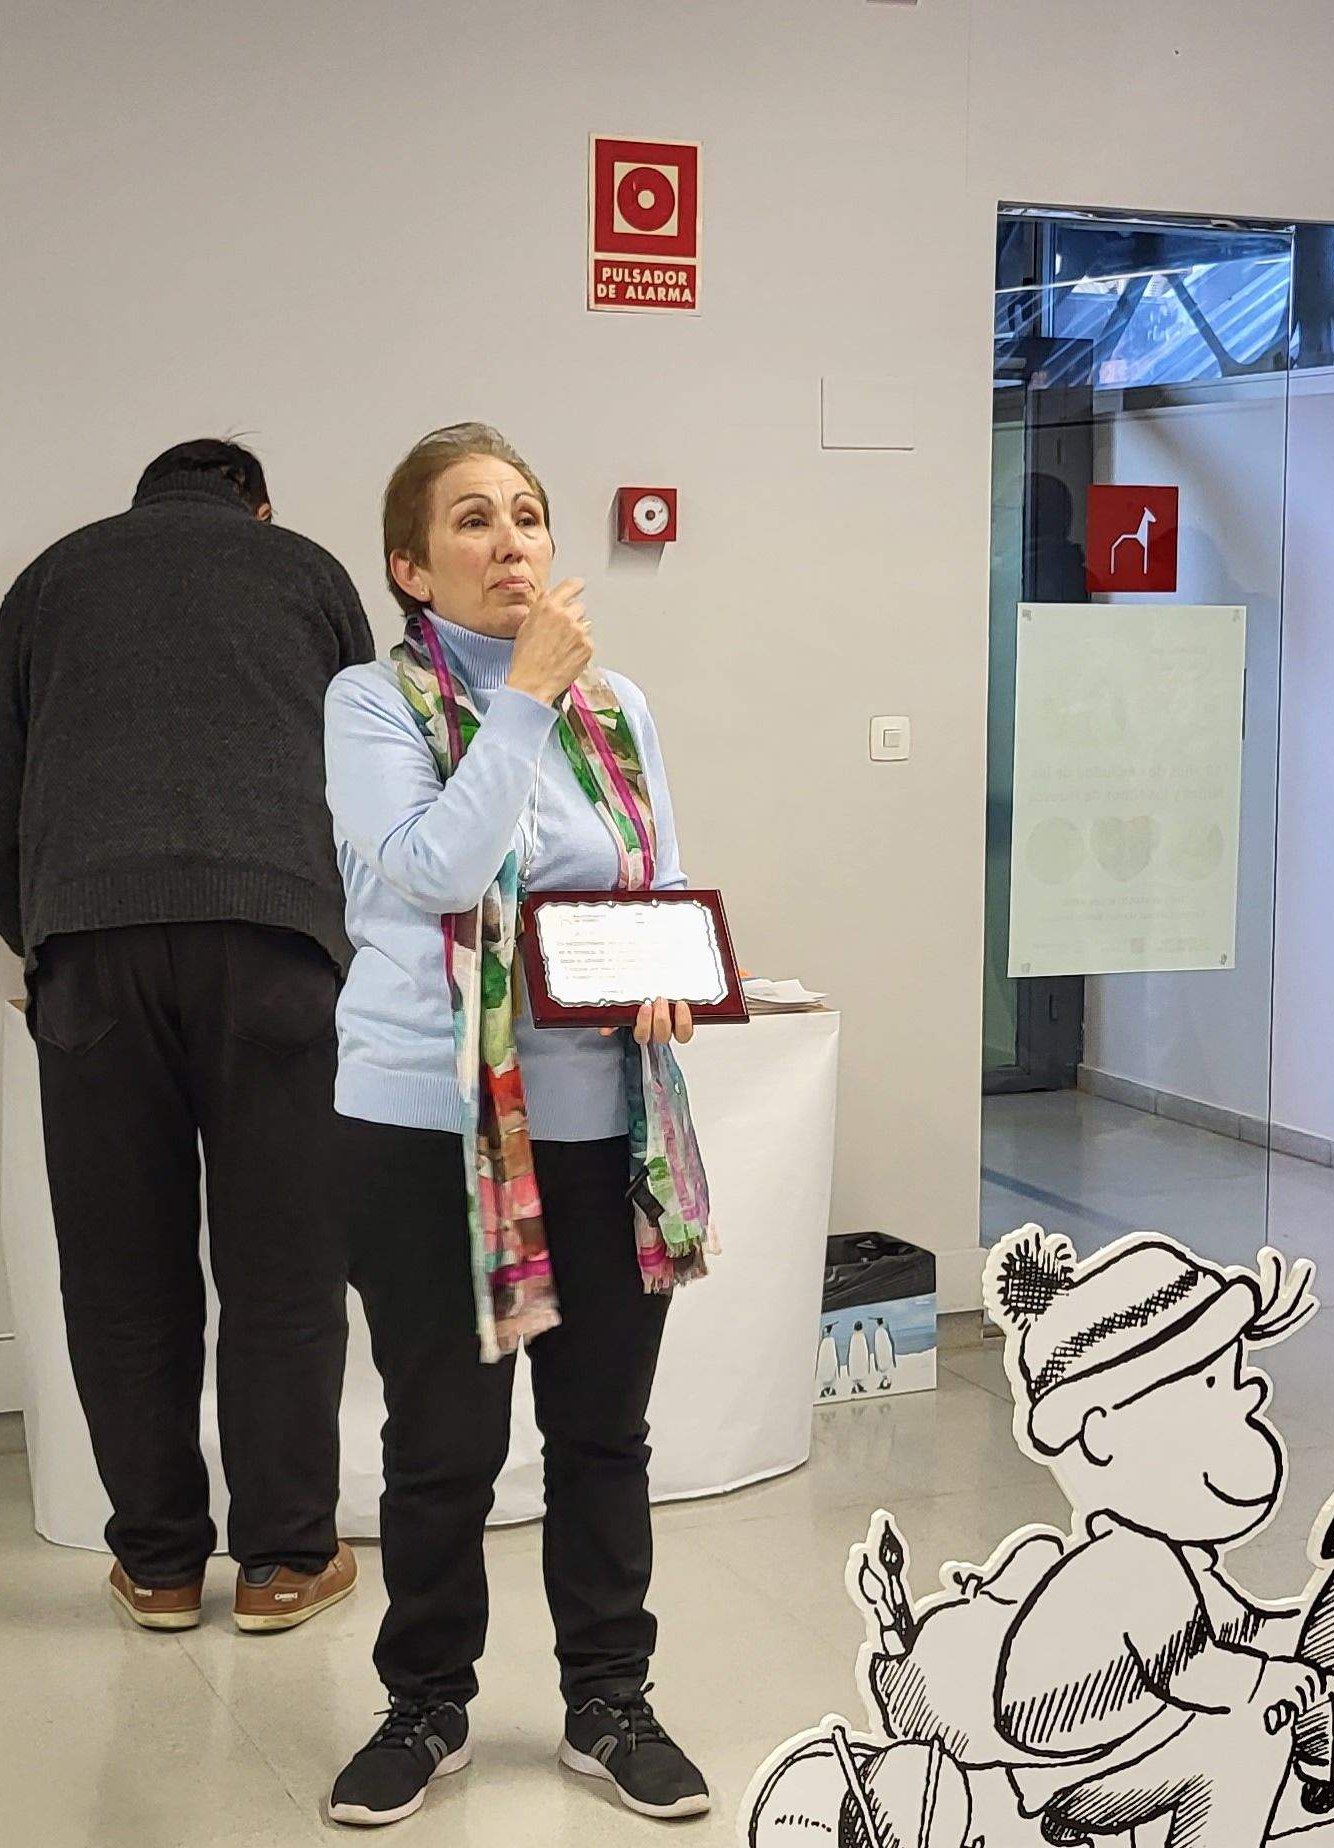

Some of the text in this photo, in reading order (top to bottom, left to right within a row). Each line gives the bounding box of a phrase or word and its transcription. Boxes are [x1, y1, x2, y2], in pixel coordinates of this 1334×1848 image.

[602, 267, 688, 286] PULSADOR
[596, 283, 692, 302] DE ALARMA
